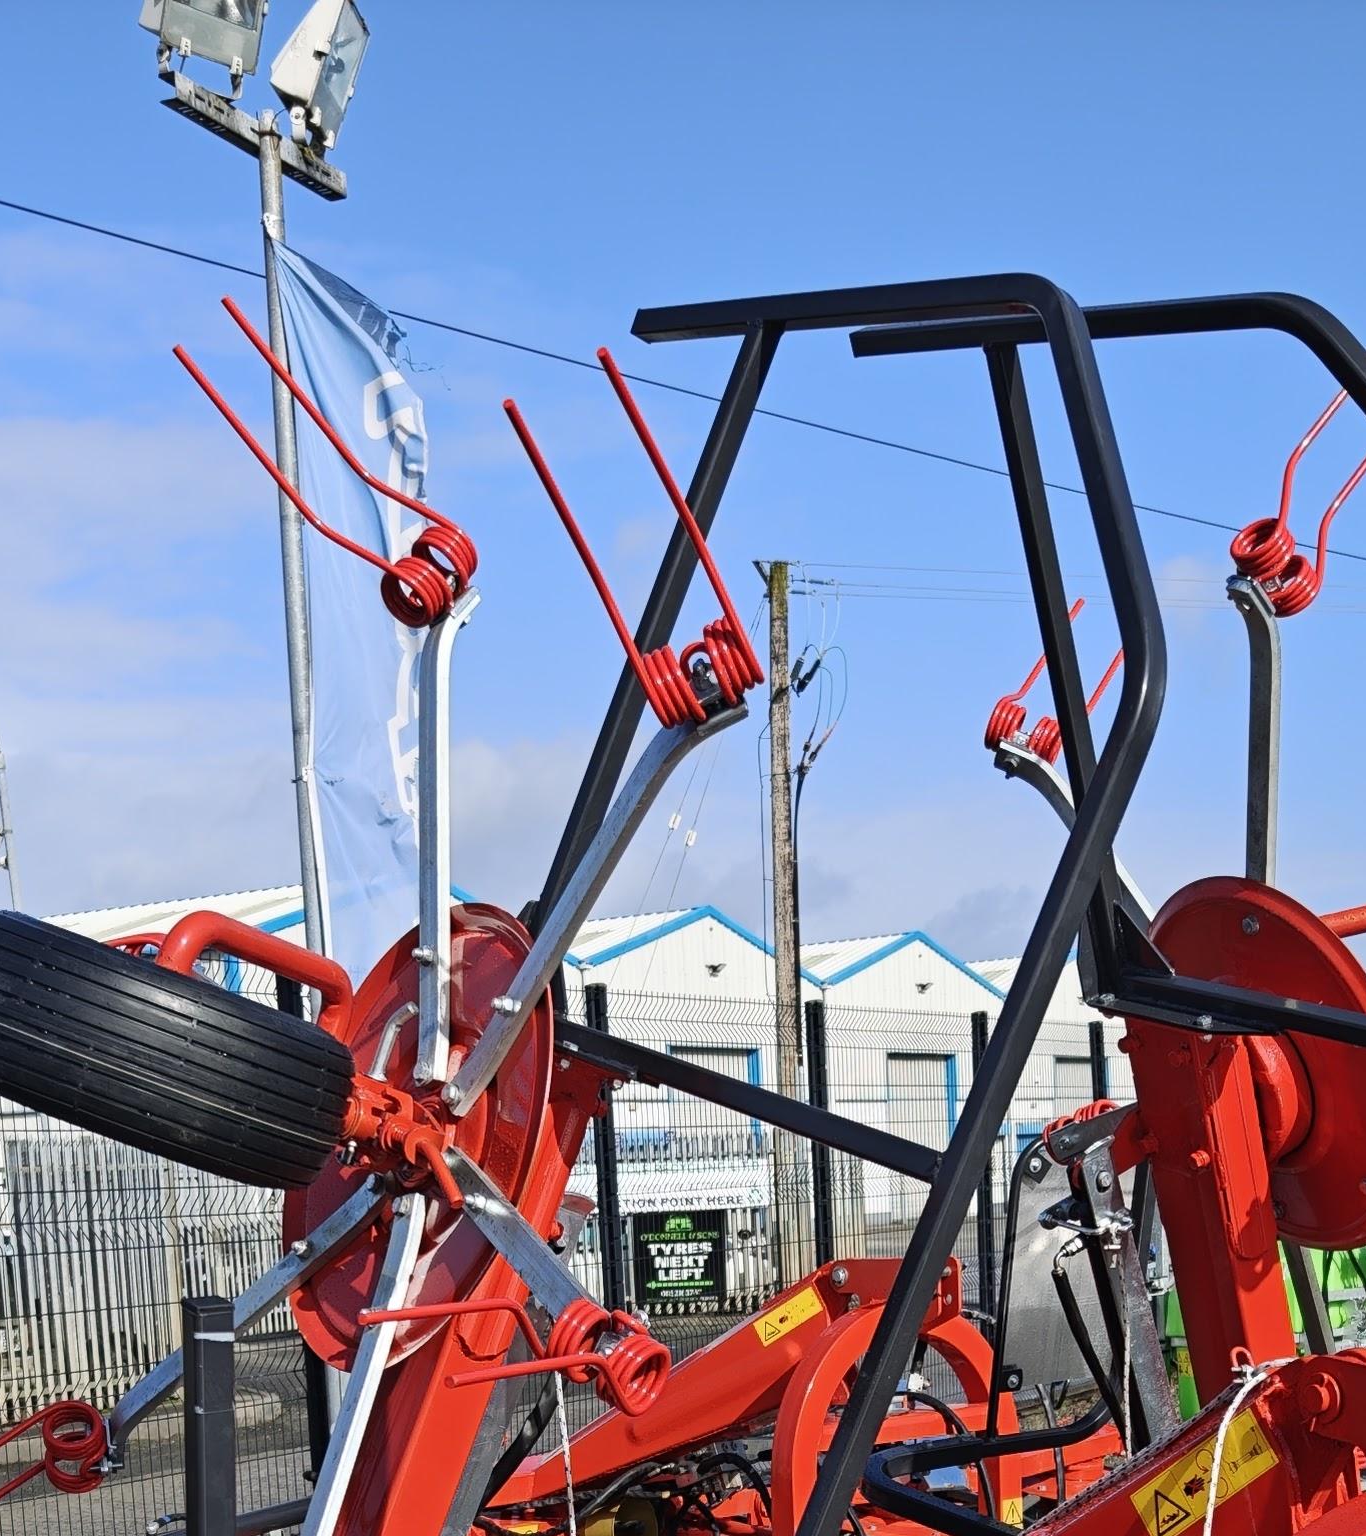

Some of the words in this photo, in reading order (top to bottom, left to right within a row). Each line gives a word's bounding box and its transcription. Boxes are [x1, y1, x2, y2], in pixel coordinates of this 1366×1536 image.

[660, 1197, 703, 1208] POINT
[707, 1195, 744, 1206] HERE
[647, 1242, 713, 1256] TYRES
[654, 1255, 708, 1269] NEXT
[658, 1268, 705, 1281] LEFT
